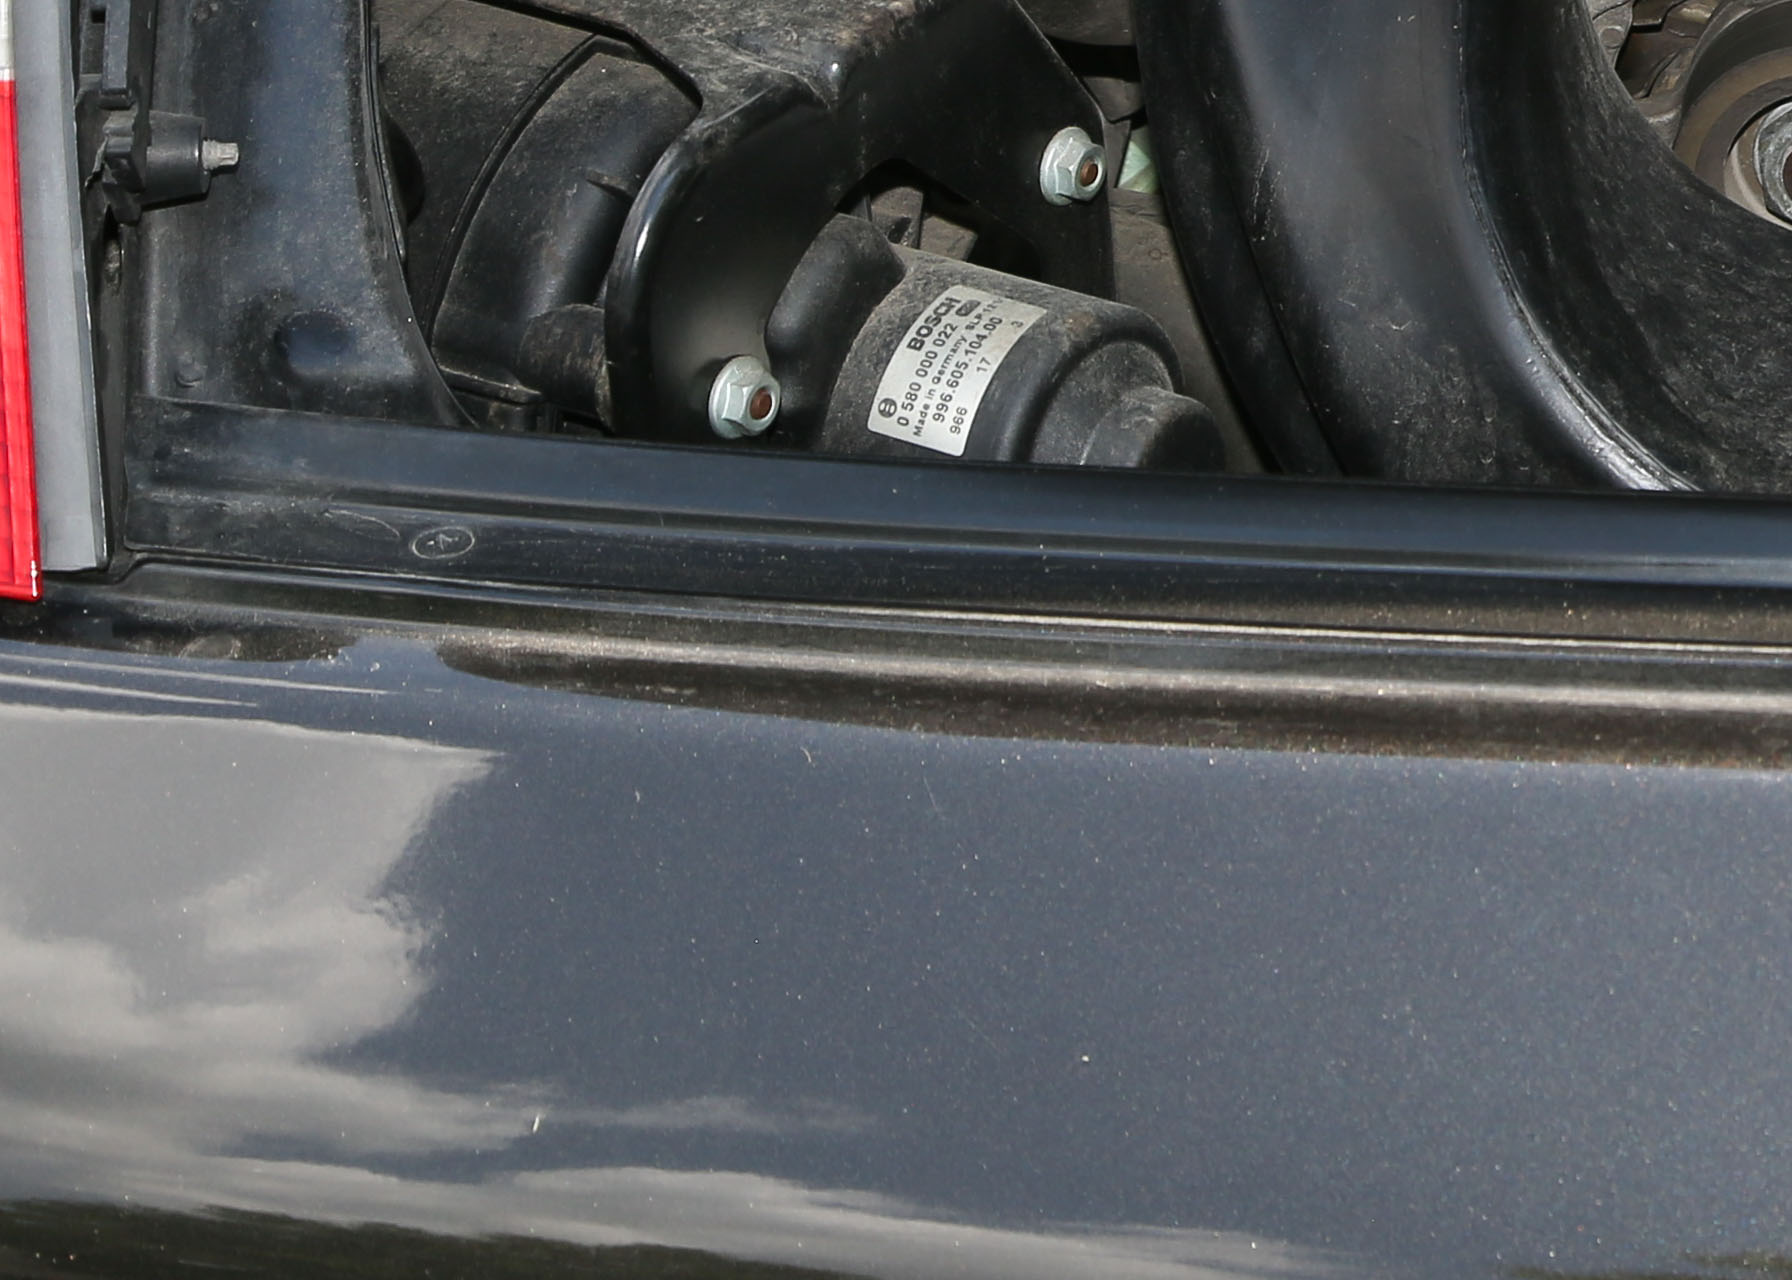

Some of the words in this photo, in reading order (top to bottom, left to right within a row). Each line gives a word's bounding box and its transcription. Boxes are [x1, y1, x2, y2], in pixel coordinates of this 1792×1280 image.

[907, 297, 962, 352] BOSCH
[933, 323, 958, 348] 022
[915, 351, 938, 378] 000
[932, 317, 1003, 424] 996.605.104.00
[901, 382, 922, 412] 580
[913, 404, 930, 437] Made
[925, 388, 936, 400] in
[932, 335, 968, 385] Germany
[950, 406, 968, 434] 966
[976, 357, 991, 373] 17
[897, 416, 909, 427] 0
